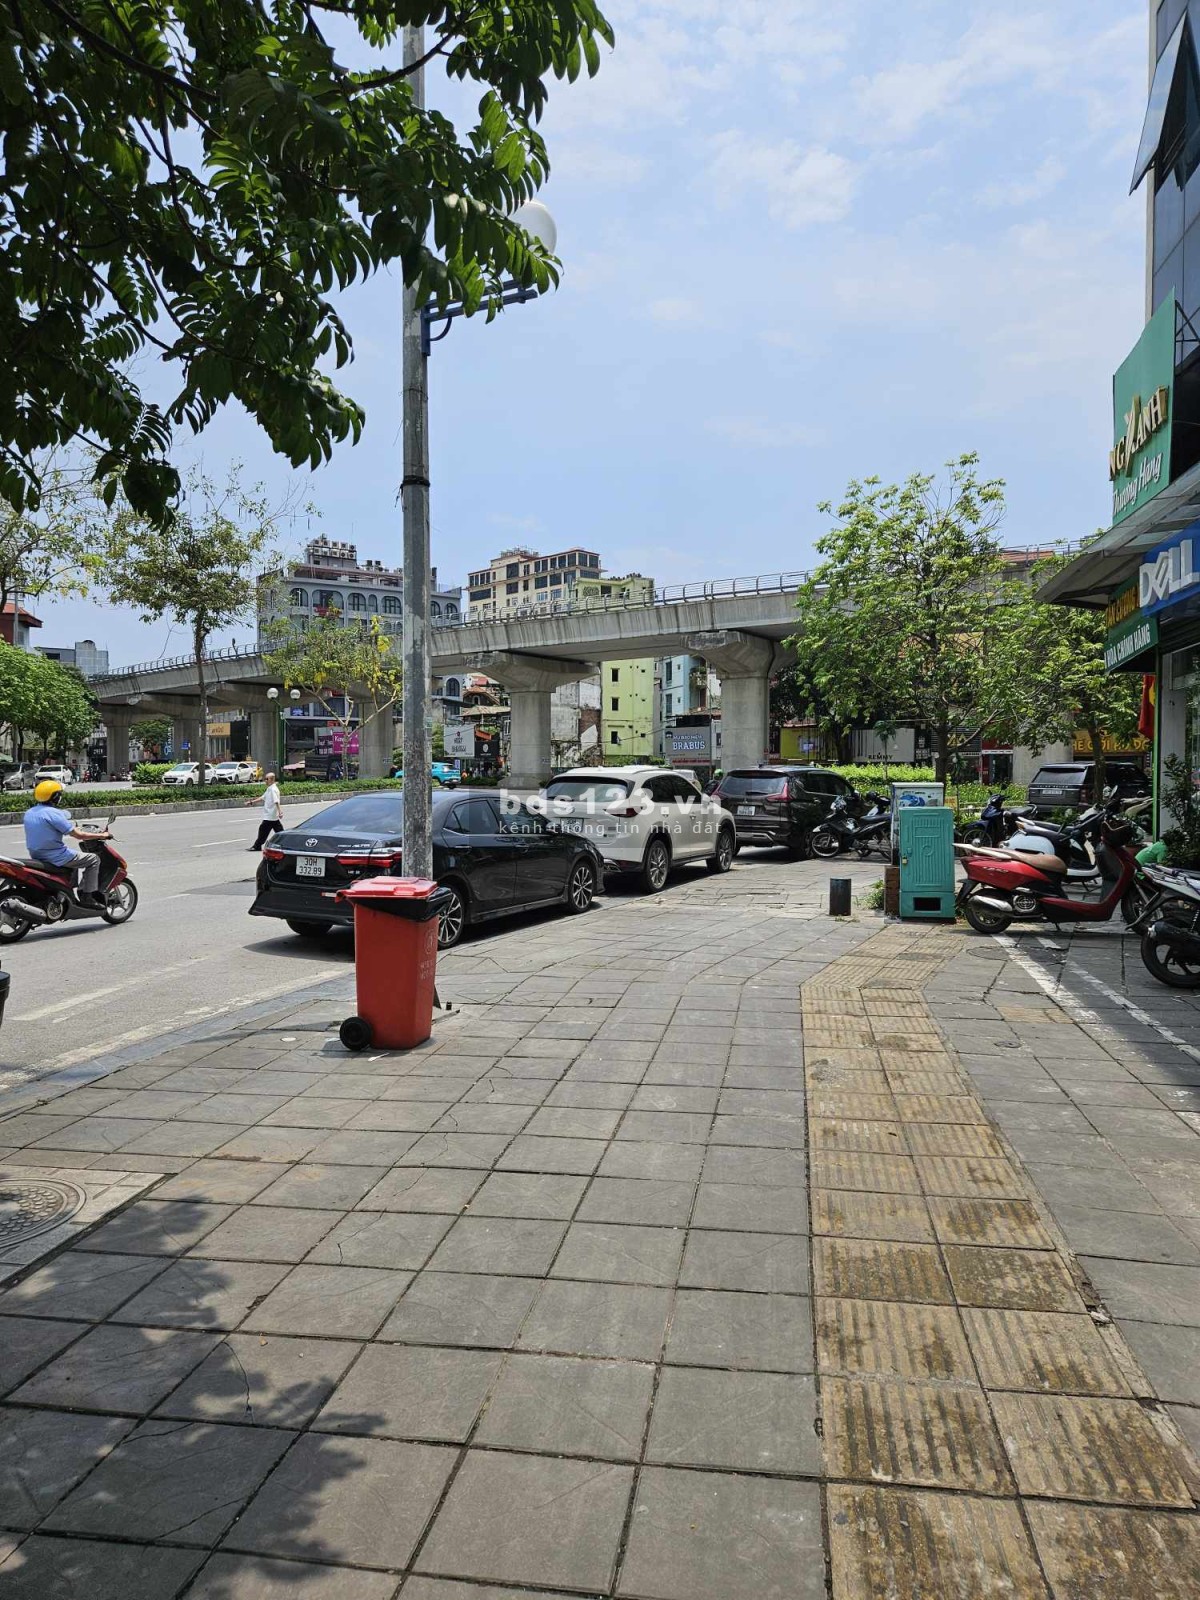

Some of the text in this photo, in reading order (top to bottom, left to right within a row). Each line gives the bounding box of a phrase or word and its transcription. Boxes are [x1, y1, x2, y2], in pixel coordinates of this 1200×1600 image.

[1139, 539, 1200, 608] DELL
[672, 741, 706, 750] BRABUS
[304, 857, 318, 867] 30H
[298, 866, 322, 876] 332.89
